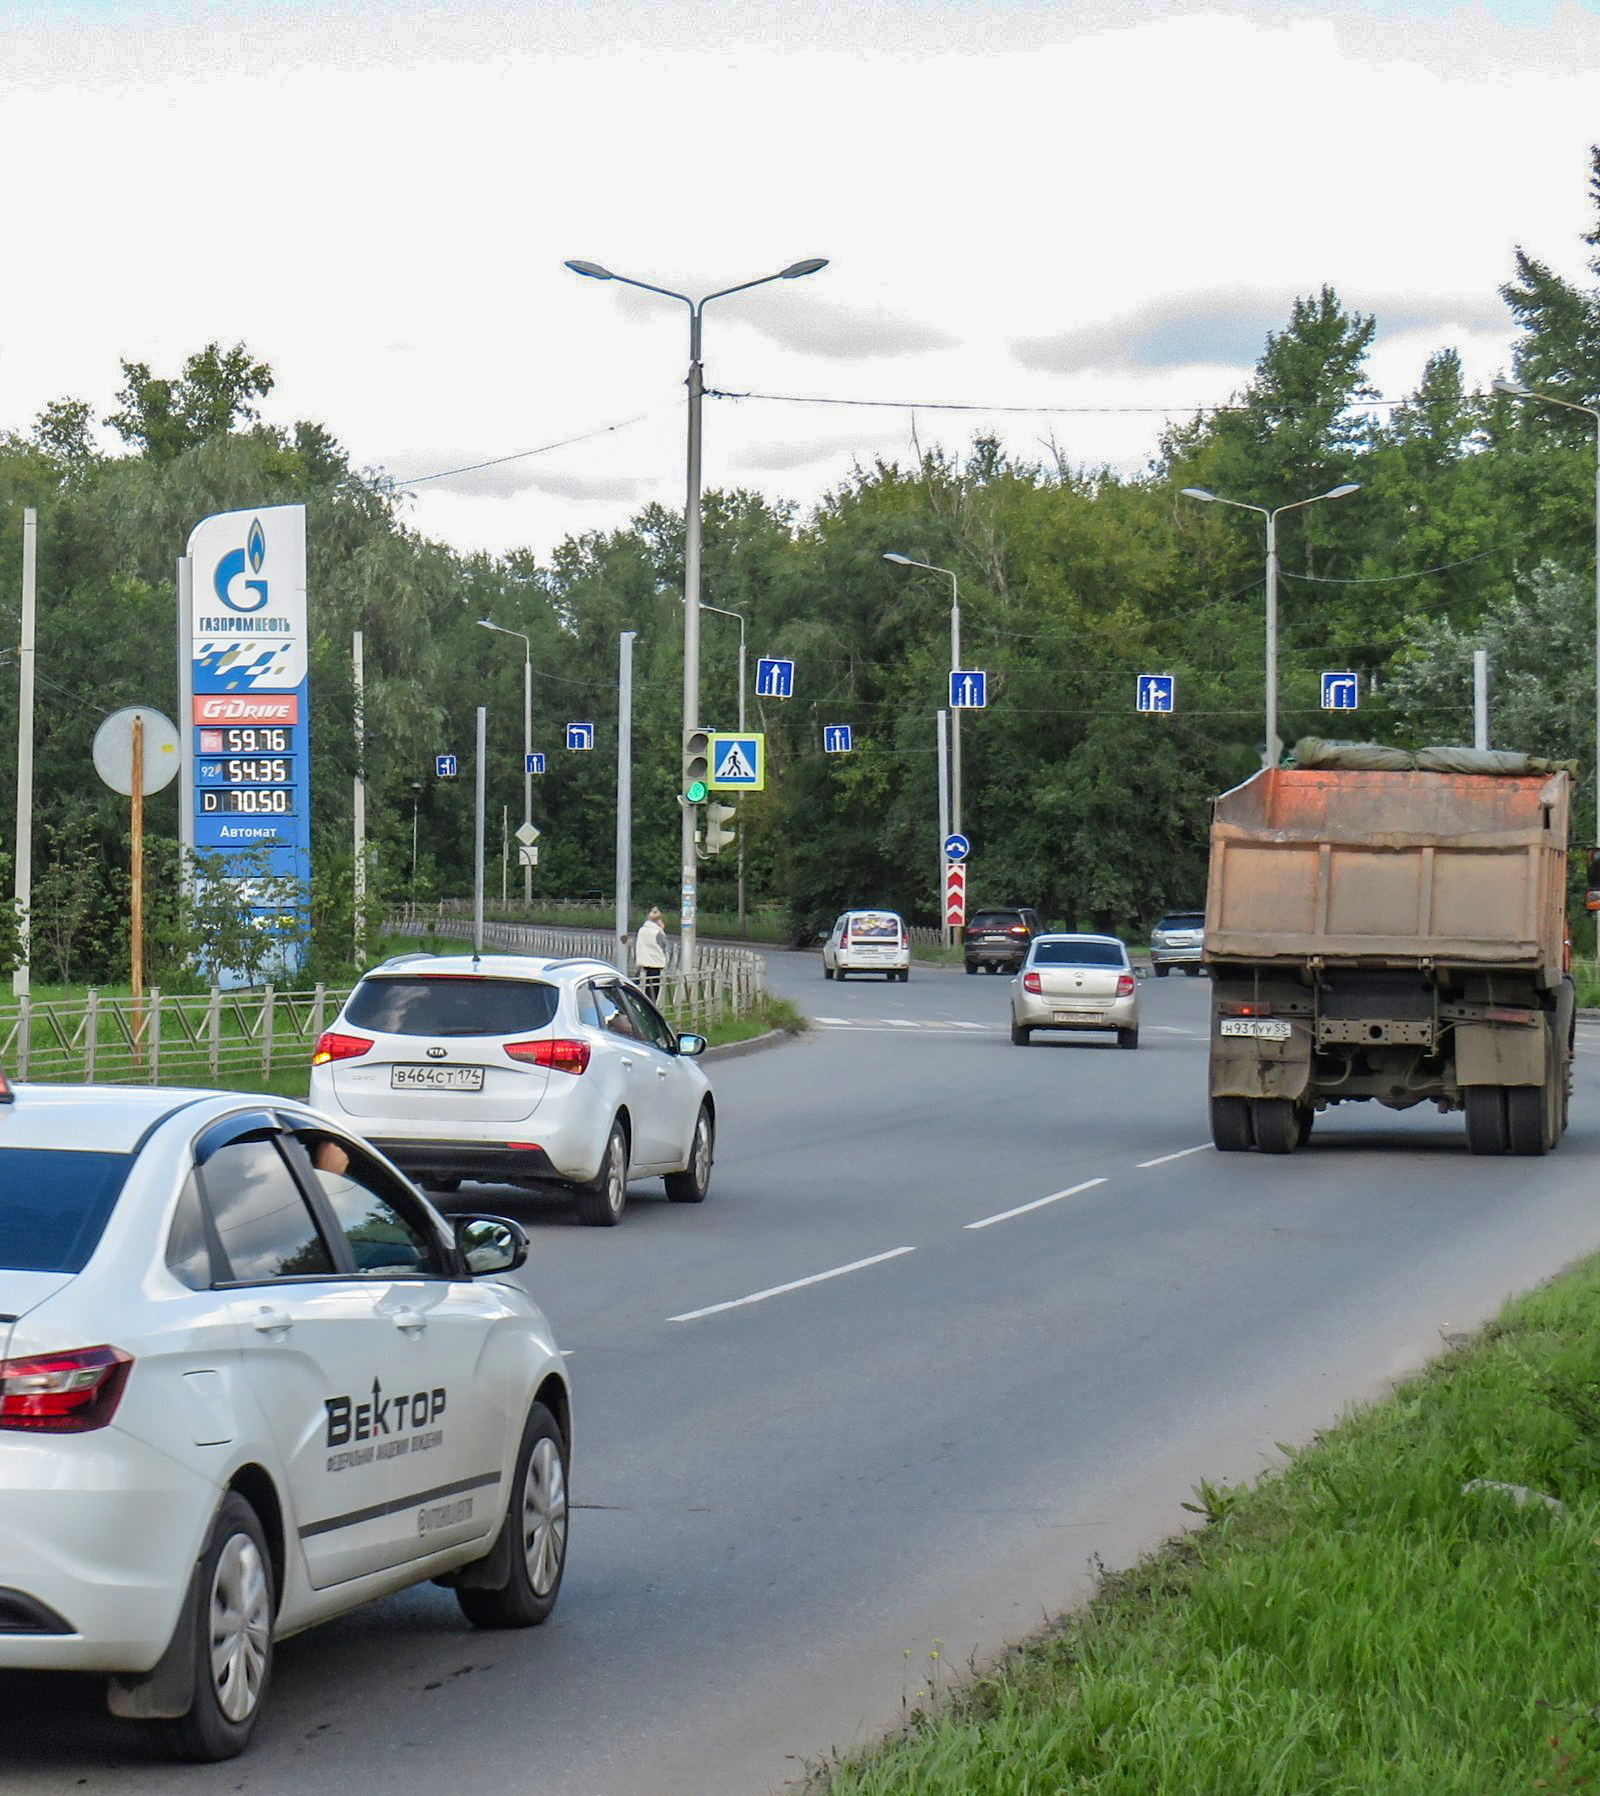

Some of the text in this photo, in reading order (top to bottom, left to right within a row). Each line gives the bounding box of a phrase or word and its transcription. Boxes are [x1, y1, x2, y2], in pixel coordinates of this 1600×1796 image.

[199, 616, 291, 633] ГАЗПРОМНЕФТЬ
[228, 729, 286, 752] 59.76
[201, 760, 286, 782] 92 54.35
[204, 790, 287, 813] D 70.50
[220, 826, 277, 839] Автомат
[429, 1048, 445, 1056] KIA
[458, 1069, 481, 1081] 174
